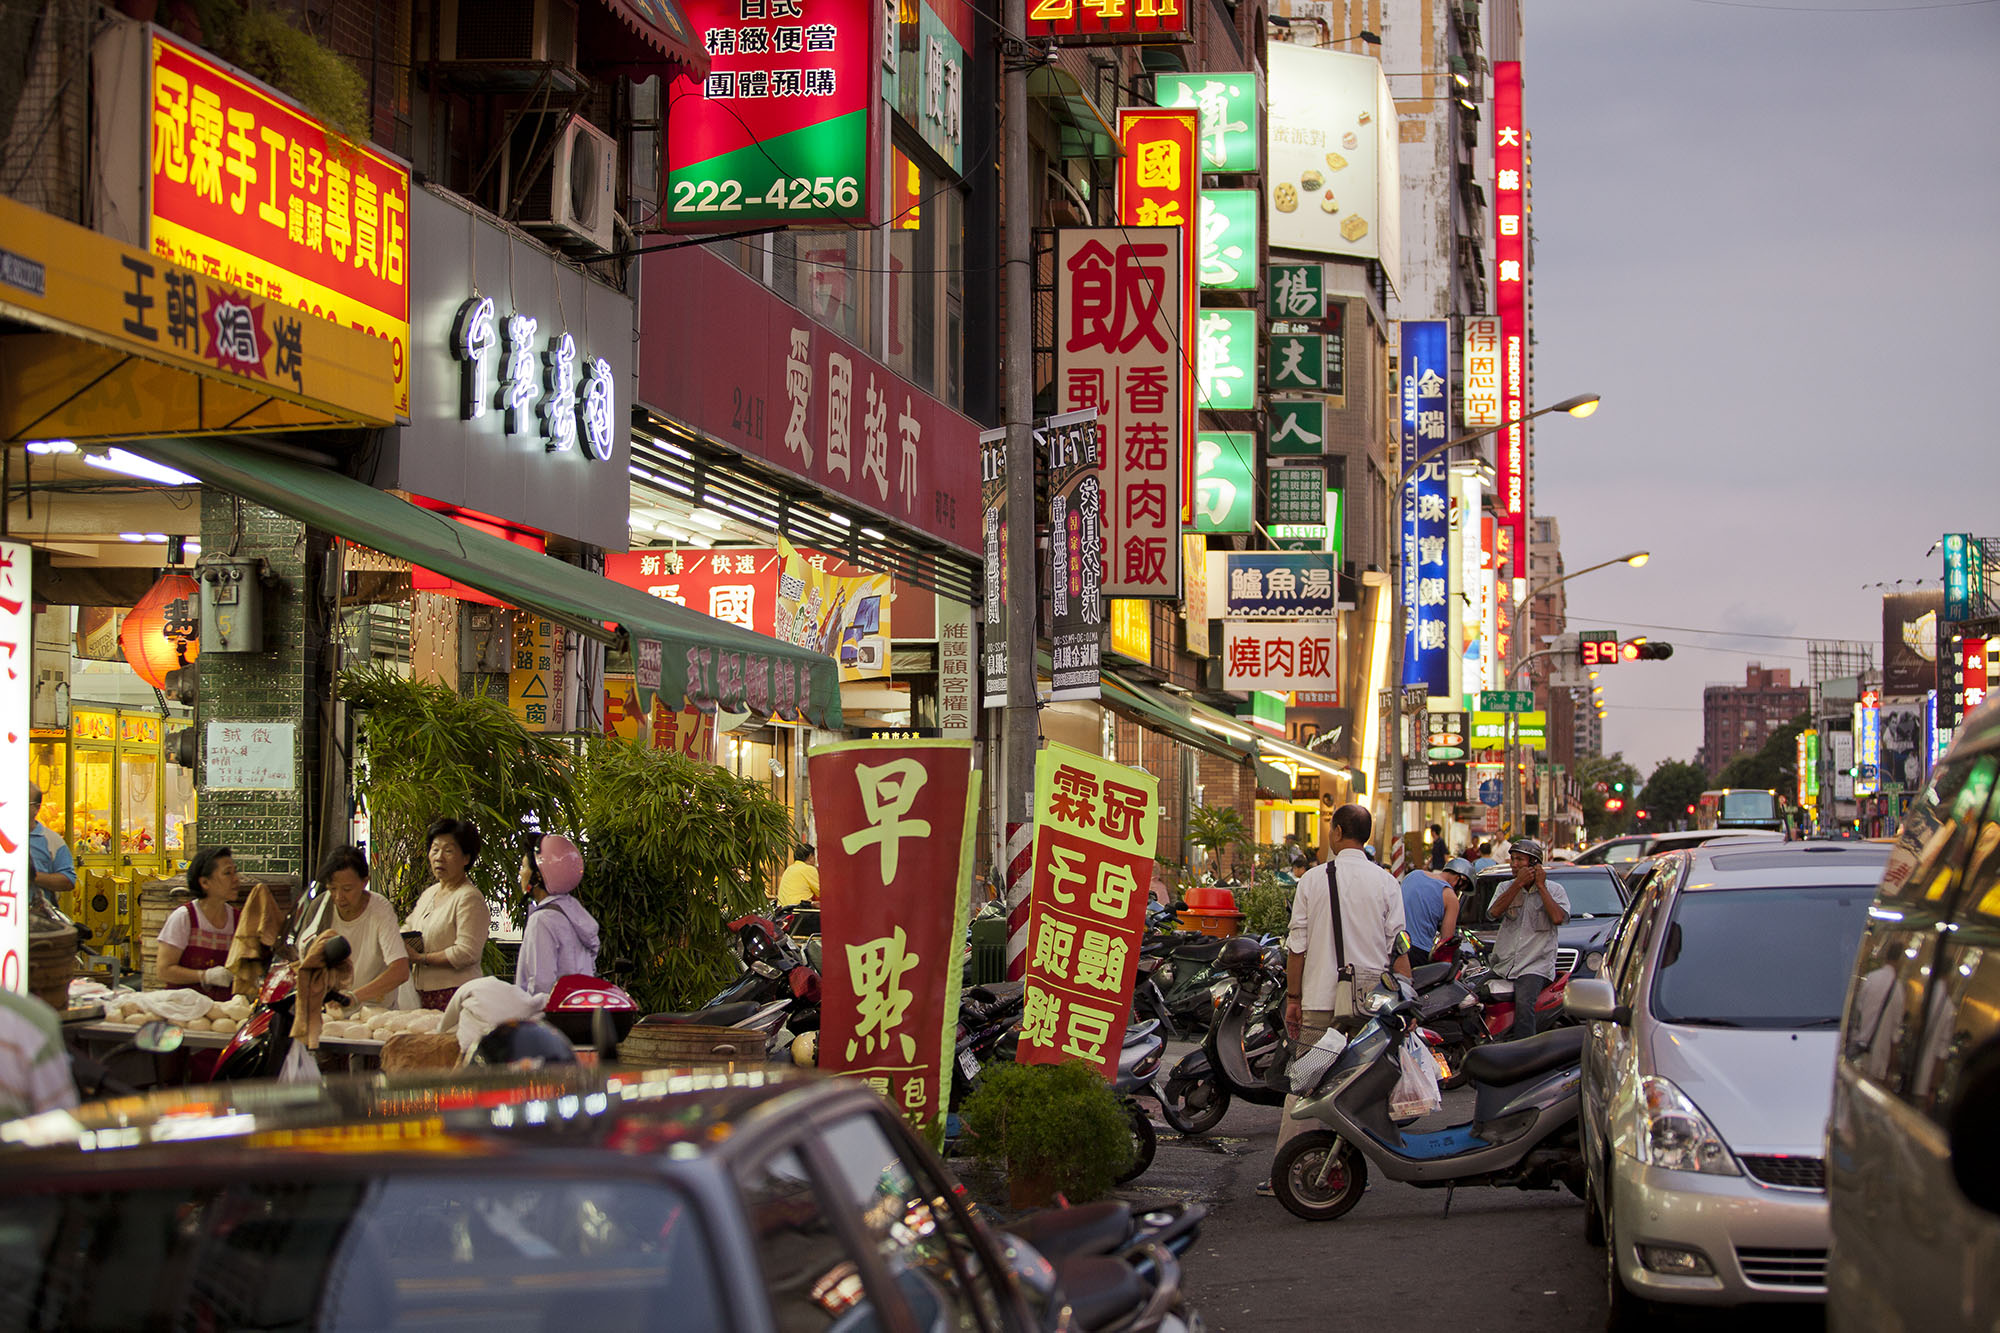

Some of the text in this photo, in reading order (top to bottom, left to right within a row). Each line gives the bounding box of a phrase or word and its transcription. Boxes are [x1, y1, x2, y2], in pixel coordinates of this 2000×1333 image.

[706, 25, 837, 55] 精緻便當
[703, 68, 836, 100] 團體預購
[673, 176, 859, 213] 222-4256
[1497, 126, 1520, 282] 大統百貨
[1066, 239, 1169, 354] 飯
[1468, 320, 1497, 427] 得恩堂
[1508, 336, 1520, 397] PRESIDENT
[1404, 374, 1414, 421] CHIN
[784, 327, 922, 516] 愛國超市
[1125, 365, 1169, 585] 香菇肉飯
[1508, 476, 1520, 513] STORE
[1418, 368, 1446, 650] 金瑞元珠寶銀樓
[1231, 568, 1331, 600] 鱸魚湯
[218, 615, 231, 634] 5
[943, 622, 968, 729] 維護顧客權益
[1228, 636, 1331, 678] 燒肉飯
[1583, 641, 1617, 665] 39
[1487, 692, 1526, 703] 六合路
[841, 756, 932, 1065] 早點
